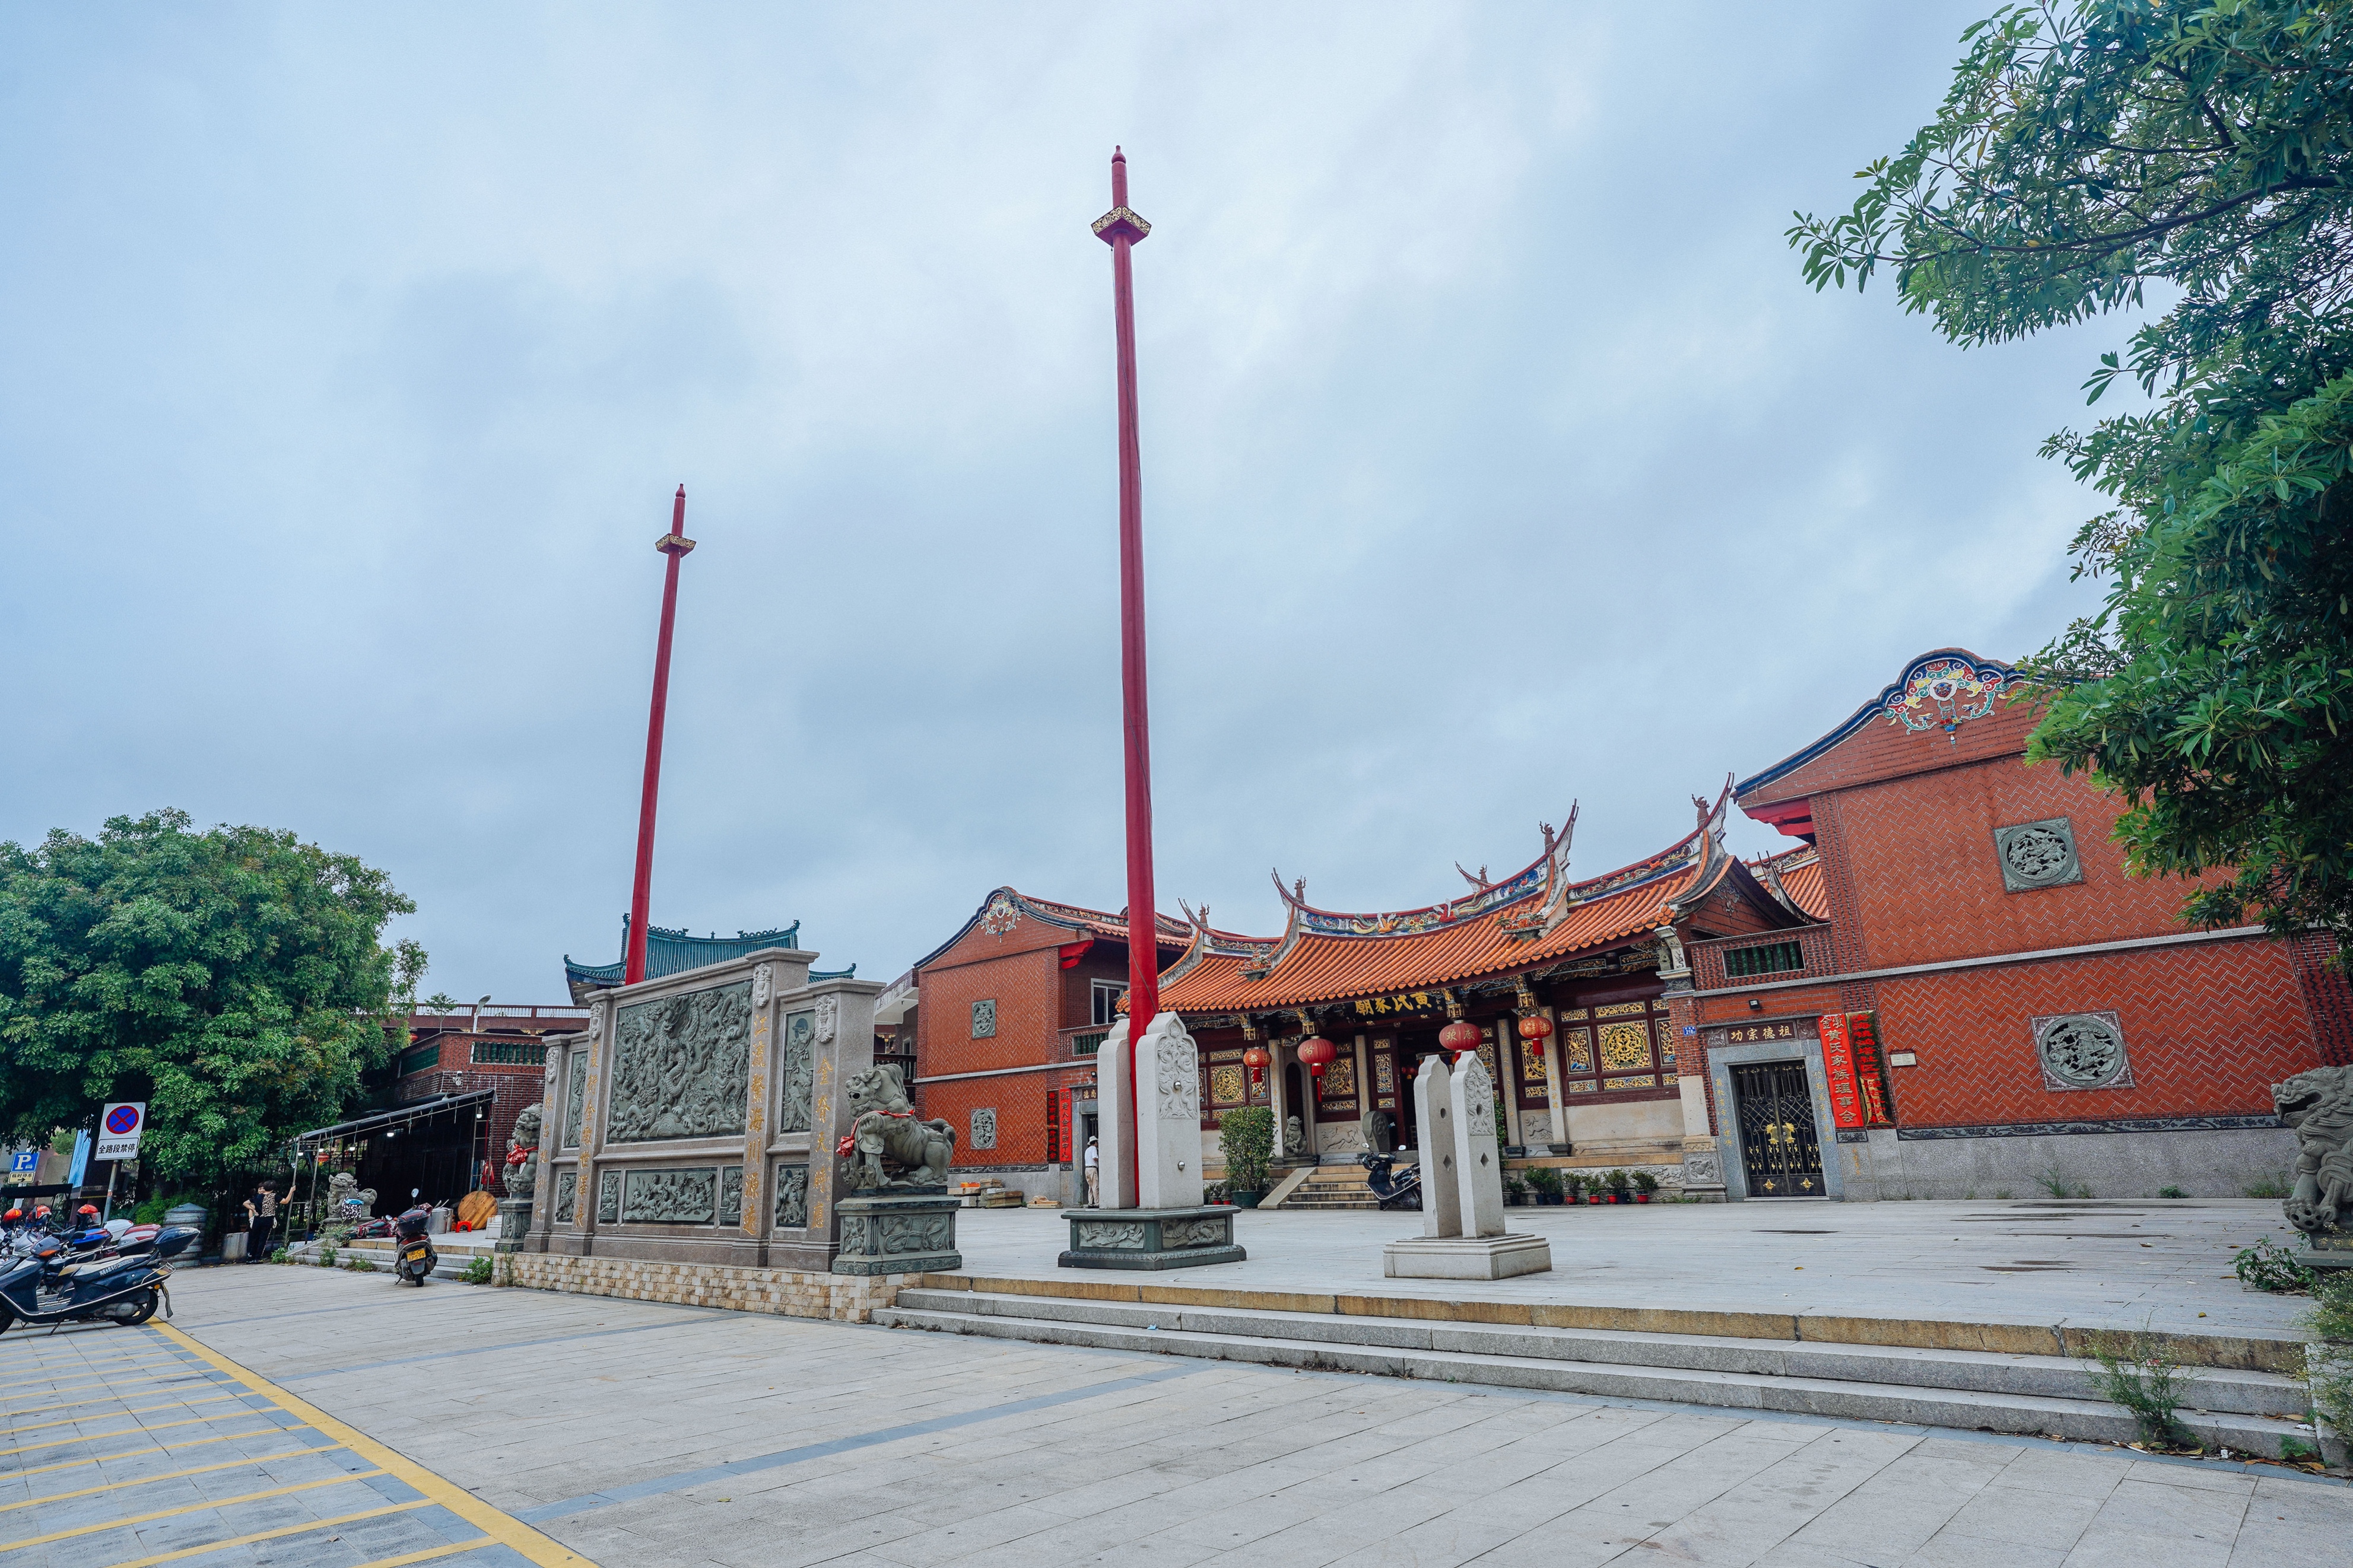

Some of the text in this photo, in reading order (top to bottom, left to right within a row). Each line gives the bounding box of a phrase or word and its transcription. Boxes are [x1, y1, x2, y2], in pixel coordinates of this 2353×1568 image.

[1446, 1029, 1475, 1041] 欢度
[1730, 1025, 1792, 1042] 祖德宗功
[98, 1143, 135, 1154] 全路段禁停
[15, 1154, 31, 1170] P
